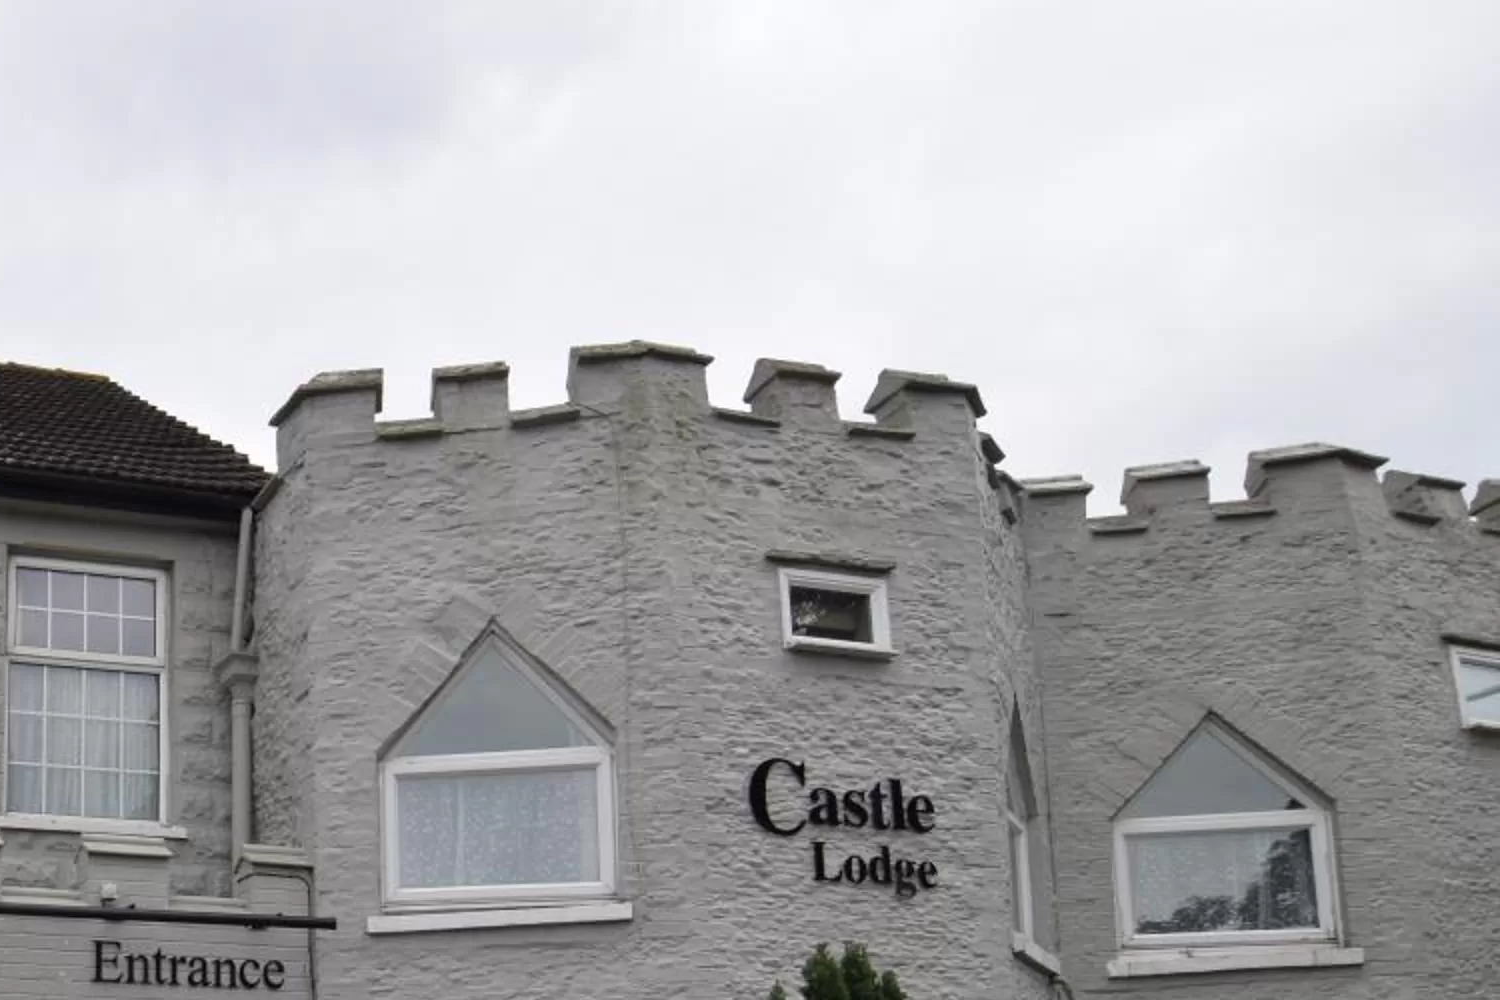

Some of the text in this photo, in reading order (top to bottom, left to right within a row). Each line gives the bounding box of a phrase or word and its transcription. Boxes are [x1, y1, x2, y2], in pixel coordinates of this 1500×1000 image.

[749, 757, 936, 836] Castle
[810, 841, 939, 898] Lodge
[92, 939, 285, 990] Entrance
